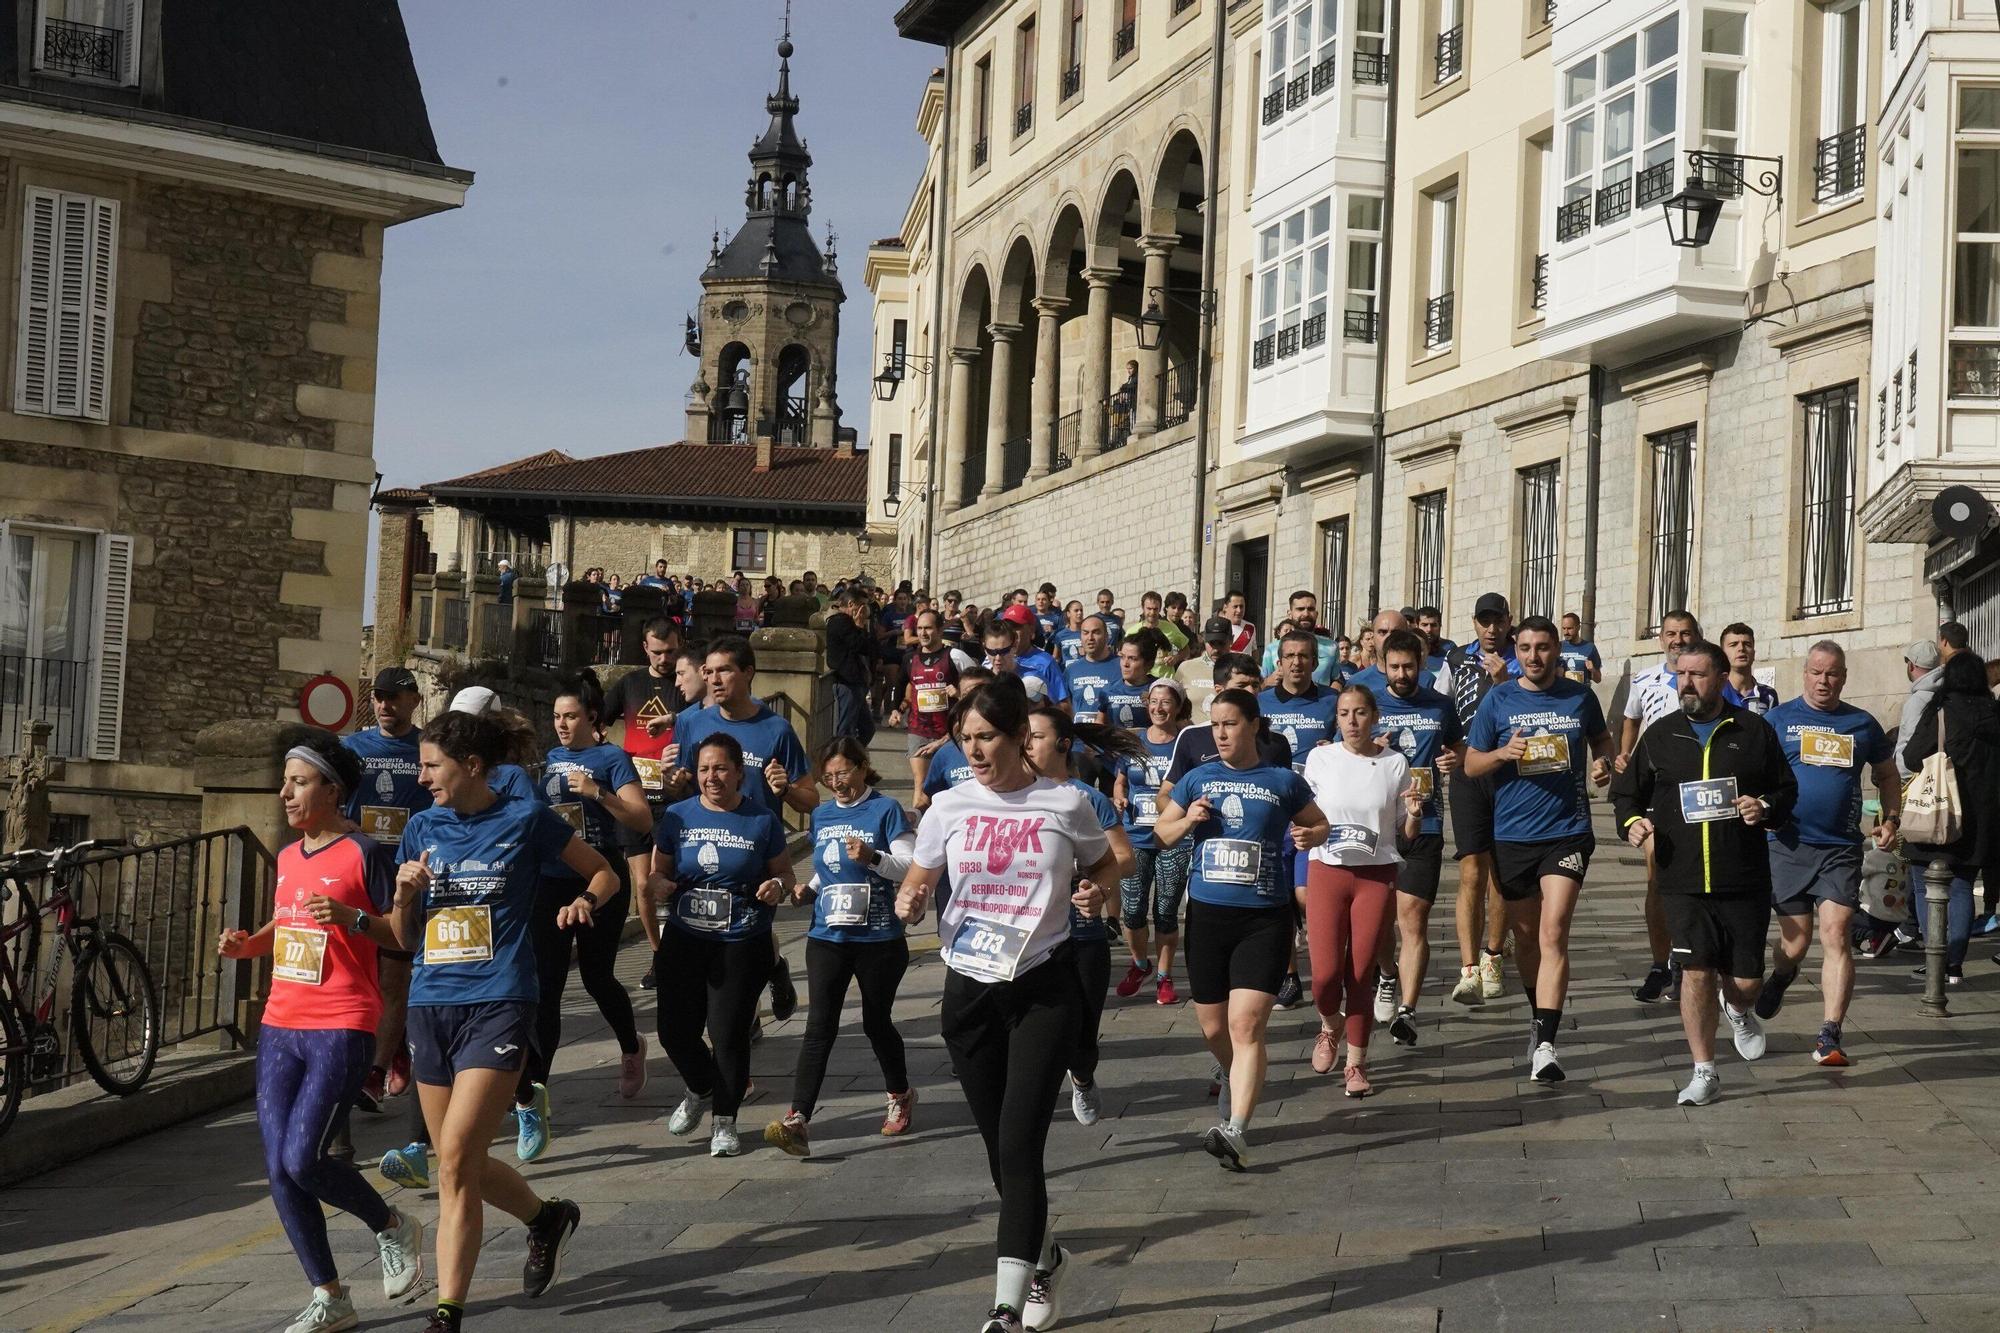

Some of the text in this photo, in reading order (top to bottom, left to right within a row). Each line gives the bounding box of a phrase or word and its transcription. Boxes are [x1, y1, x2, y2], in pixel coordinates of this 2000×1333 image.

[1388, 718, 1434, 726] ALMENDRA
[1518, 712, 1557, 720] CONQUISTA
[1520, 716, 1572, 726] ALMENDRA
[1549, 722, 1581, 730] KONKISTA
[1797, 725, 1835, 734] CONQUISTA
[1529, 744, 1556, 760] 556
[1816, 739, 1840, 753] 622
[1211, 786, 1271, 797] ALMENDRA
[1697, 789, 1723, 806] 975
[1242, 793, 1280, 806] KONKISTA
[1142, 802, 1159, 814] 90
[375, 815, 391, 830] 42
[688, 828, 730, 836] CONQUISTA
[1340, 829, 1367, 840] 929
[688, 834, 745, 844] ALMENDRA
[717, 841, 754, 851] KONKISTA
[1213, 849, 1249, 867] 1008
[1017, 871, 1043, 880] NONSTOP
[971, 883, 1028, 898] BERMEO-OION
[690, 899, 717, 916] 930
[437, 920, 470, 942] 661
[971, 930, 1006, 954] 873
[285, 941, 305, 962] 177
